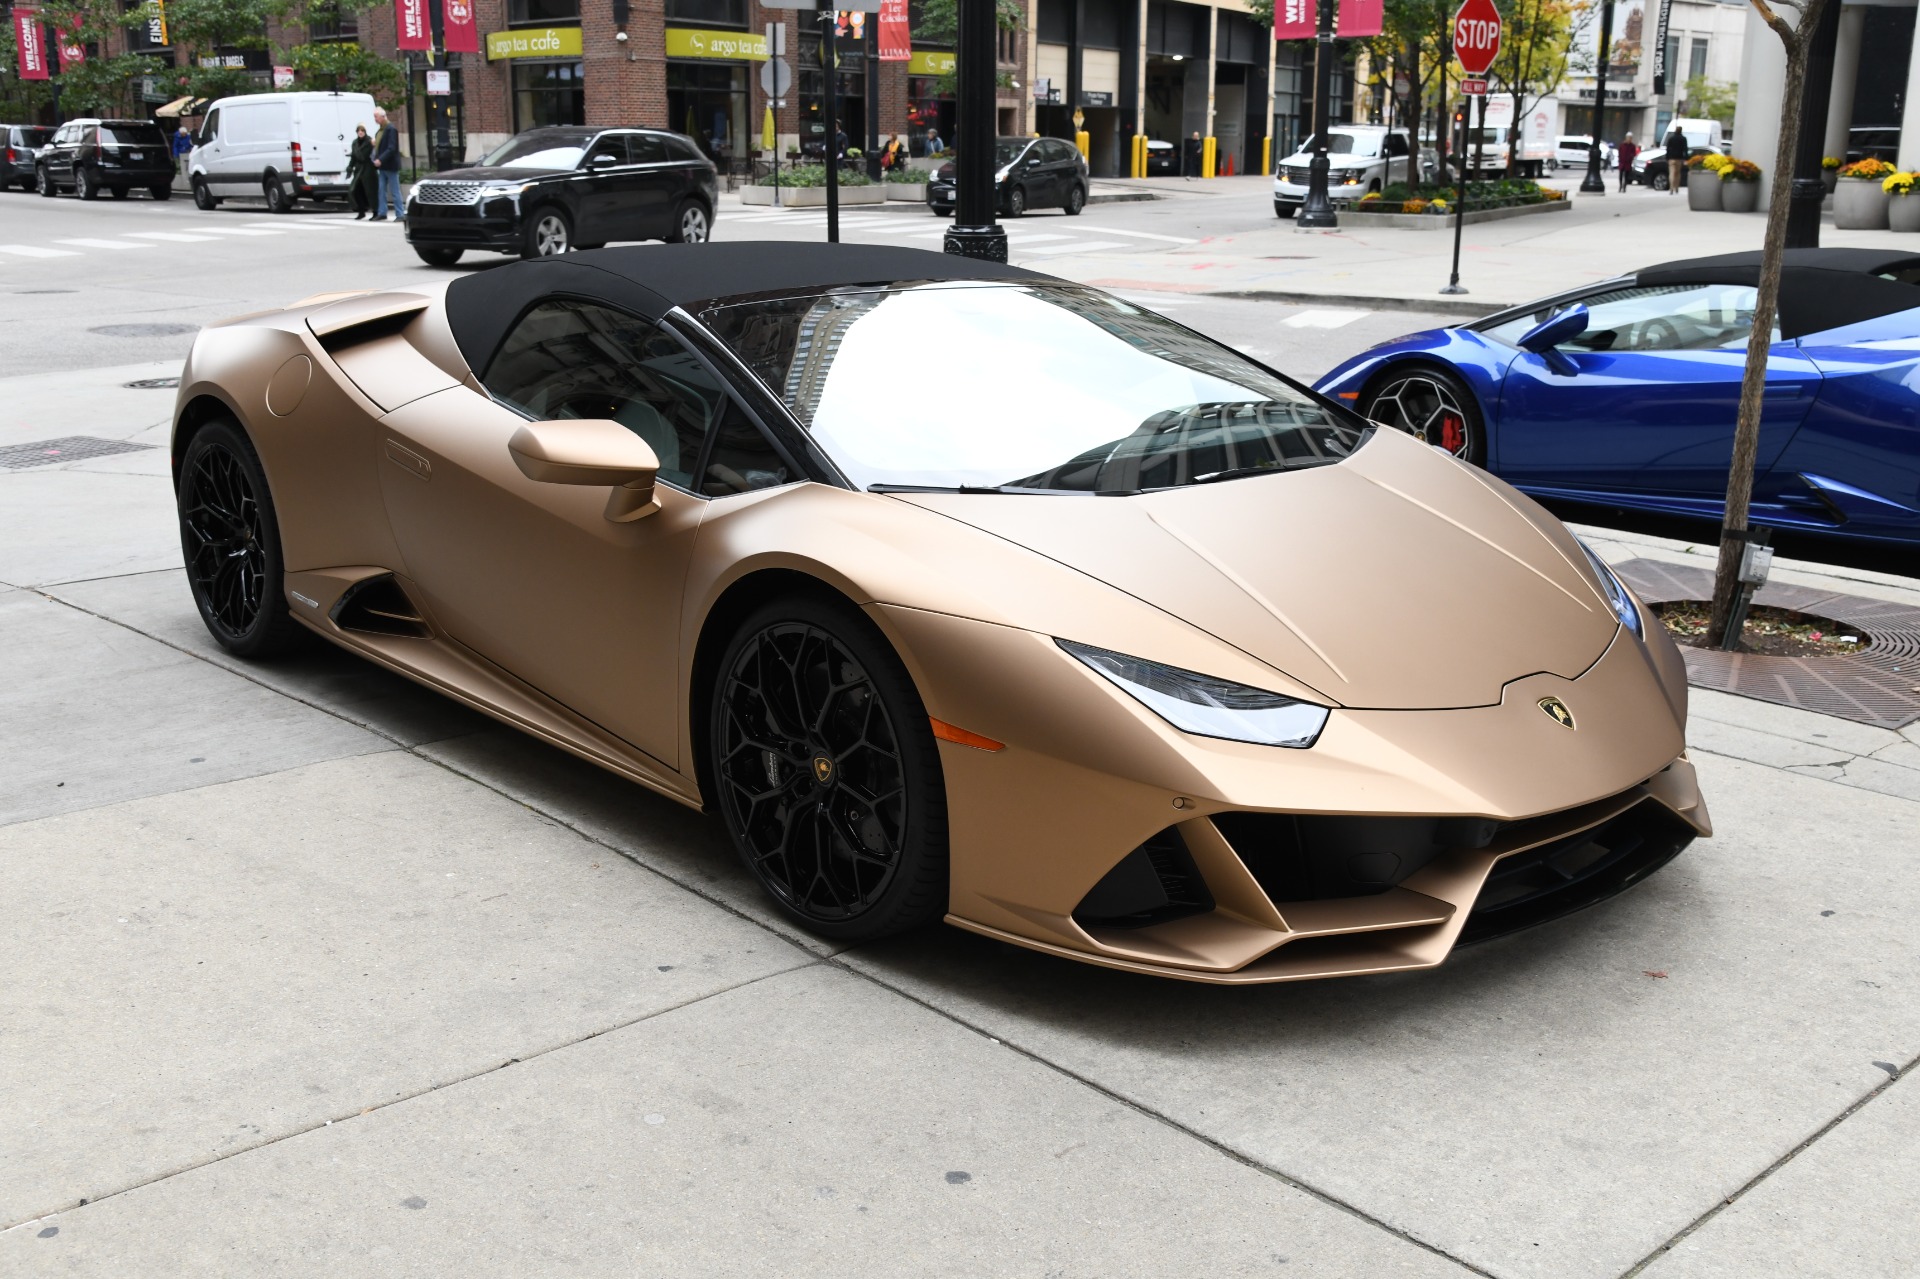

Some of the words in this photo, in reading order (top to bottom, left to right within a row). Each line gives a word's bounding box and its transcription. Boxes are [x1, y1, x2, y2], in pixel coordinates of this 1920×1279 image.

[21, 17, 35, 71] WELCOME
[496, 40, 511, 56] argo
[513, 37, 527, 52] tea
[531, 30, 560, 50] café
[1457, 18, 1498, 50] STOP
[225, 55, 244, 66] BAGELS
[711, 39, 736, 57] argo
[738, 39, 752, 54] tea
[1654, 50, 1665, 77] rack
[1463, 82, 1473, 92] ALL
[1473, 83, 1484, 93] WAY
